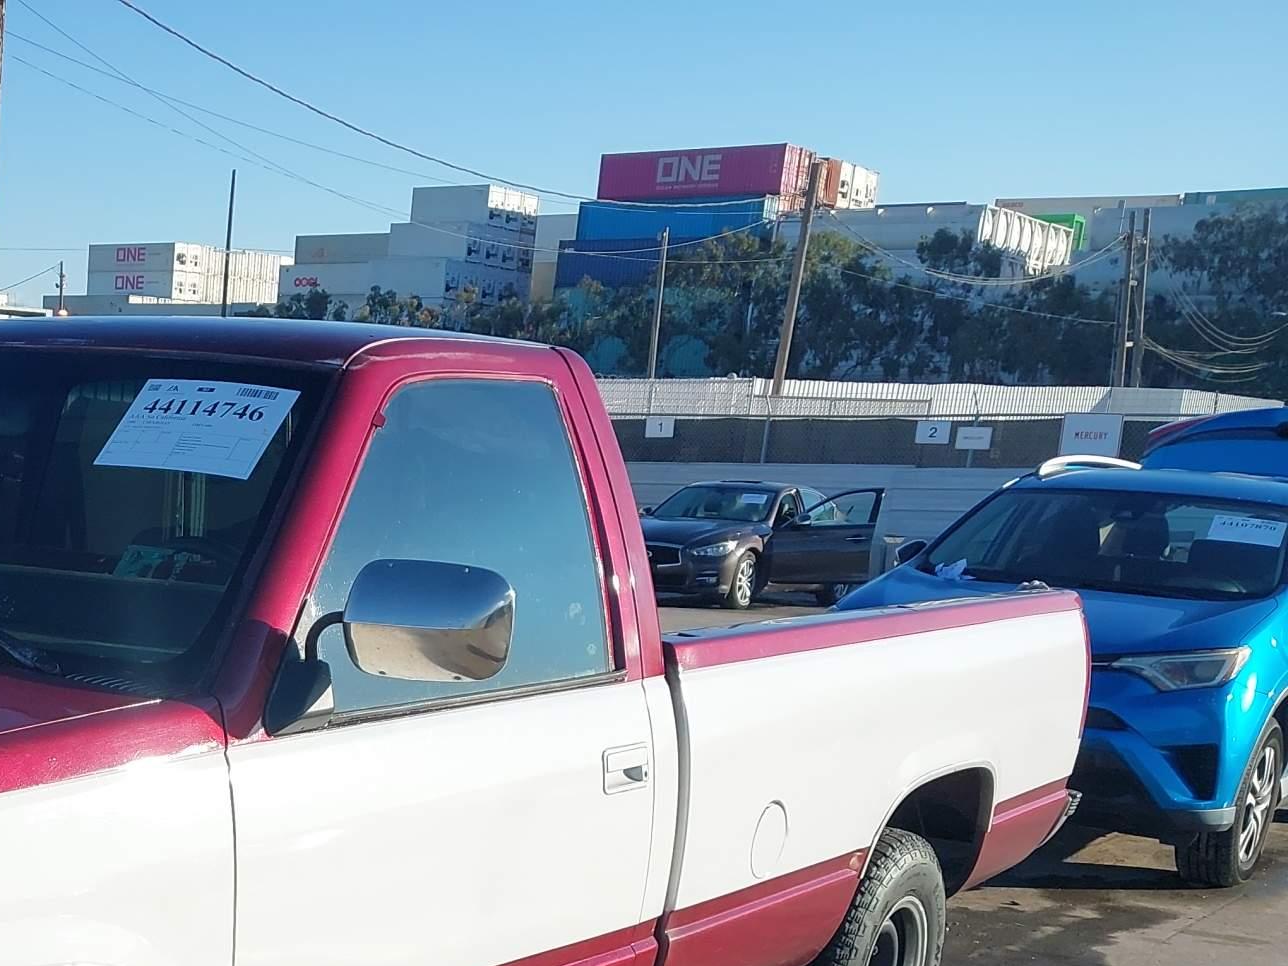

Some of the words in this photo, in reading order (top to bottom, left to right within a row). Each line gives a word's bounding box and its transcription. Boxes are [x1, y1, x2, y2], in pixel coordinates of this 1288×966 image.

[656, 154, 723, 184] ONE
[116, 247, 146, 263] ONE
[114, 275, 145, 291] ONE
[144, 398, 267, 422] 44114746
[657, 421, 664, 433] 1
[927, 426, 938, 438] 2
[1074, 431, 1109, 440] MERCURY
